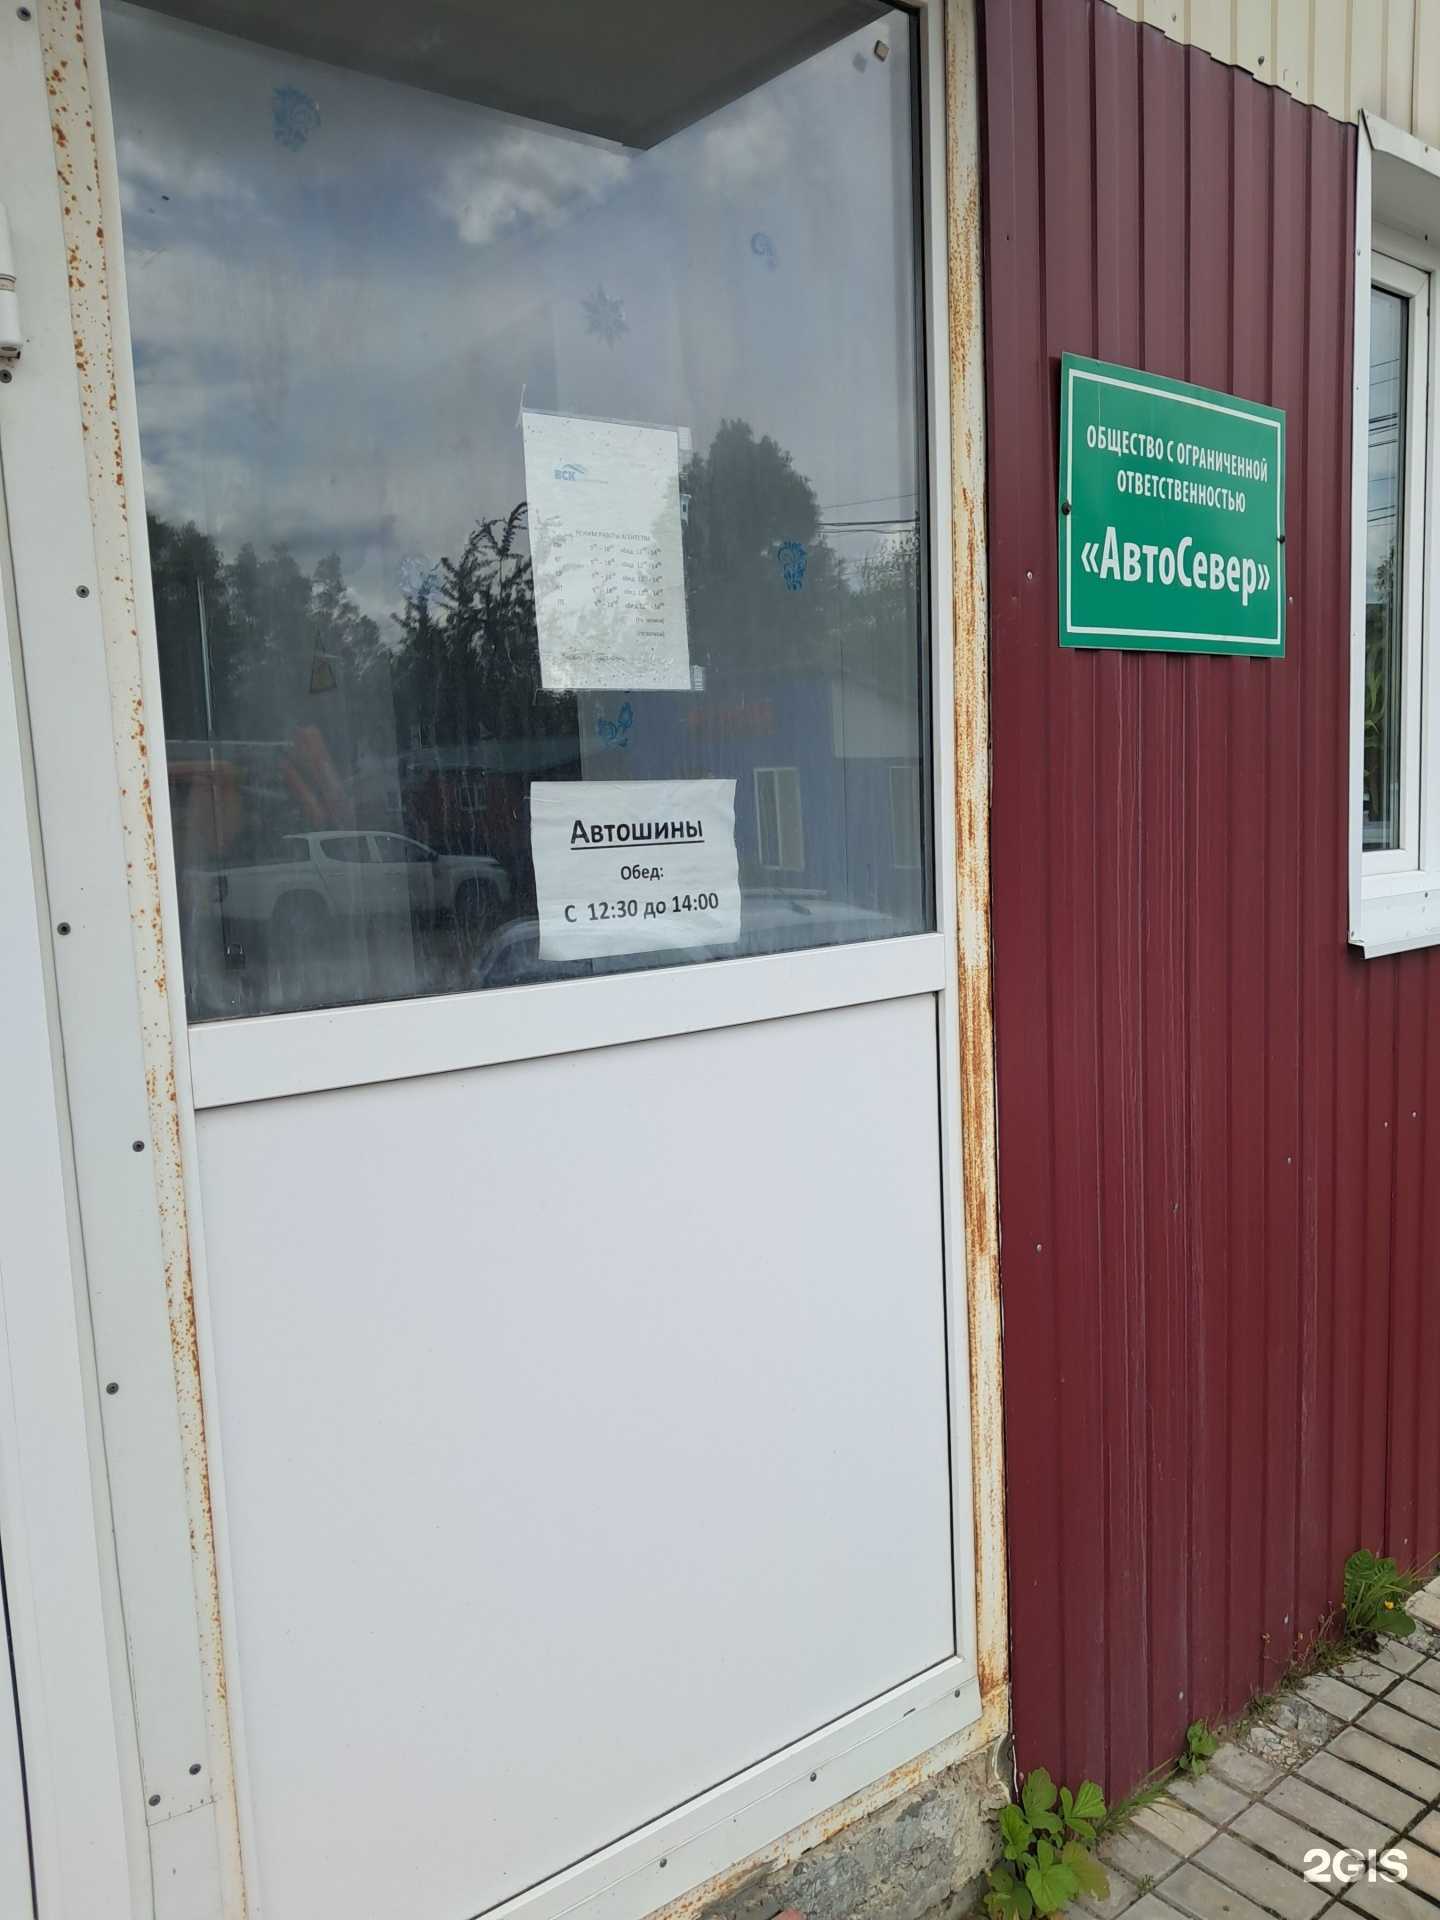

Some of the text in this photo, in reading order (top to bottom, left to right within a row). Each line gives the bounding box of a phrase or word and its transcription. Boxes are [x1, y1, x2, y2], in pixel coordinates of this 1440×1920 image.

[1086, 425, 1268, 482] ОБЩЕСТВО С ОГРАНИЧЕННОЙ
[1117, 470, 1246, 512] ОТВЕТСТВЕННОСТЬЮ
[1081, 526, 1270, 606] «АвтоСевер»
[570, 819, 703, 844] Автошины
[620, 864, 664, 880] Обед:
[564, 892, 719, 922] С 12:30 до 14:00
